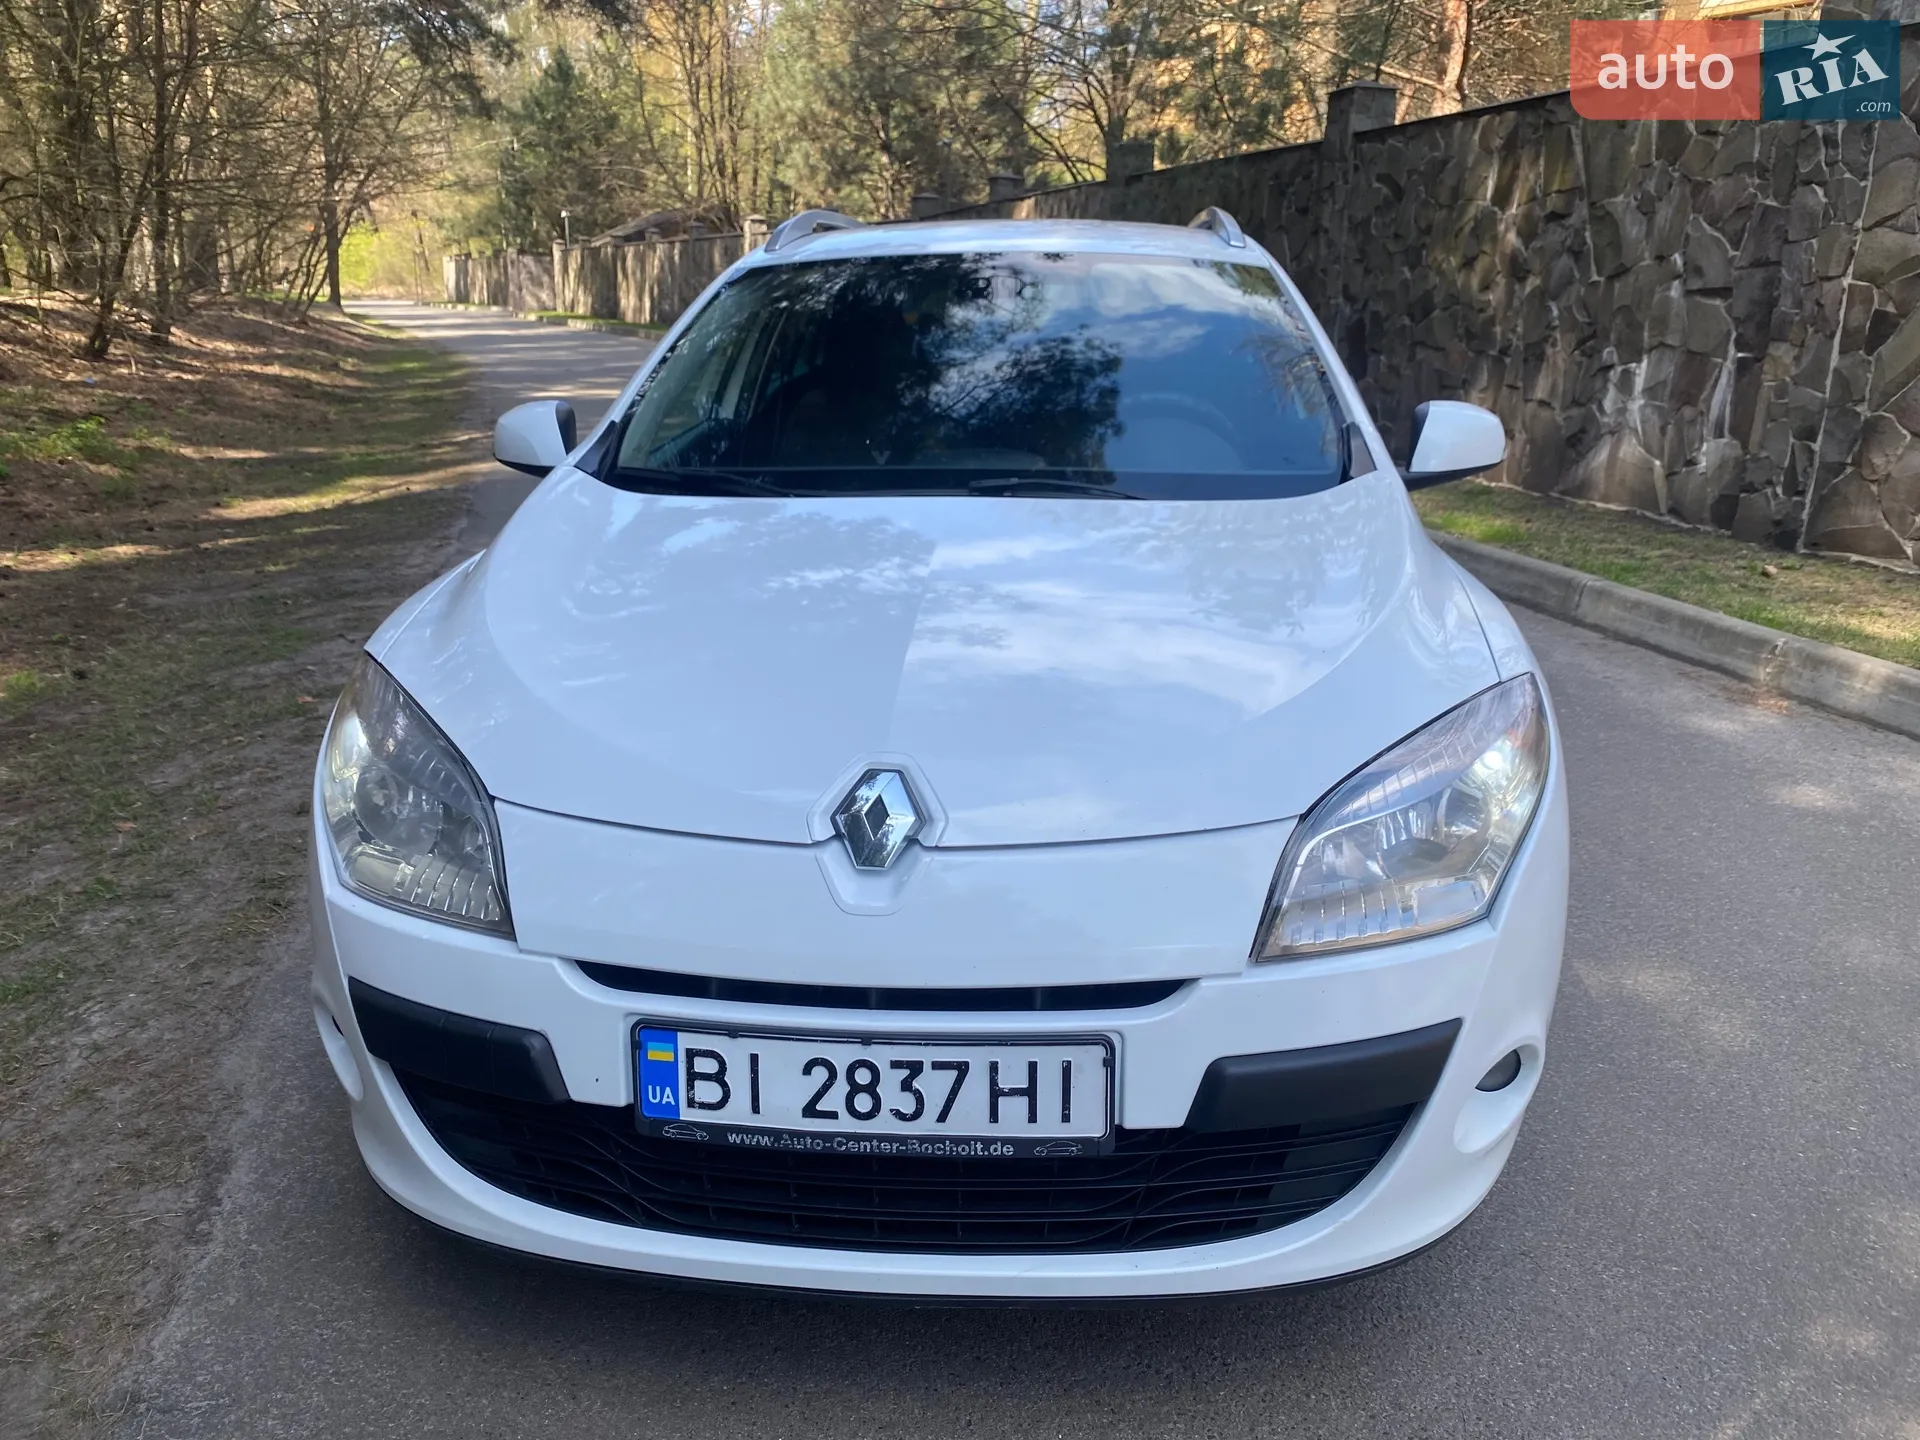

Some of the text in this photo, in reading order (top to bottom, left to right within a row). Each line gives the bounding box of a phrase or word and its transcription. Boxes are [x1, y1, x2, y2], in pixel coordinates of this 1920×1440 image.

[648, 1086, 675, 1105] UA
[686, 1047, 760, 1114] BI
[801, 1057, 970, 1123] 2837
